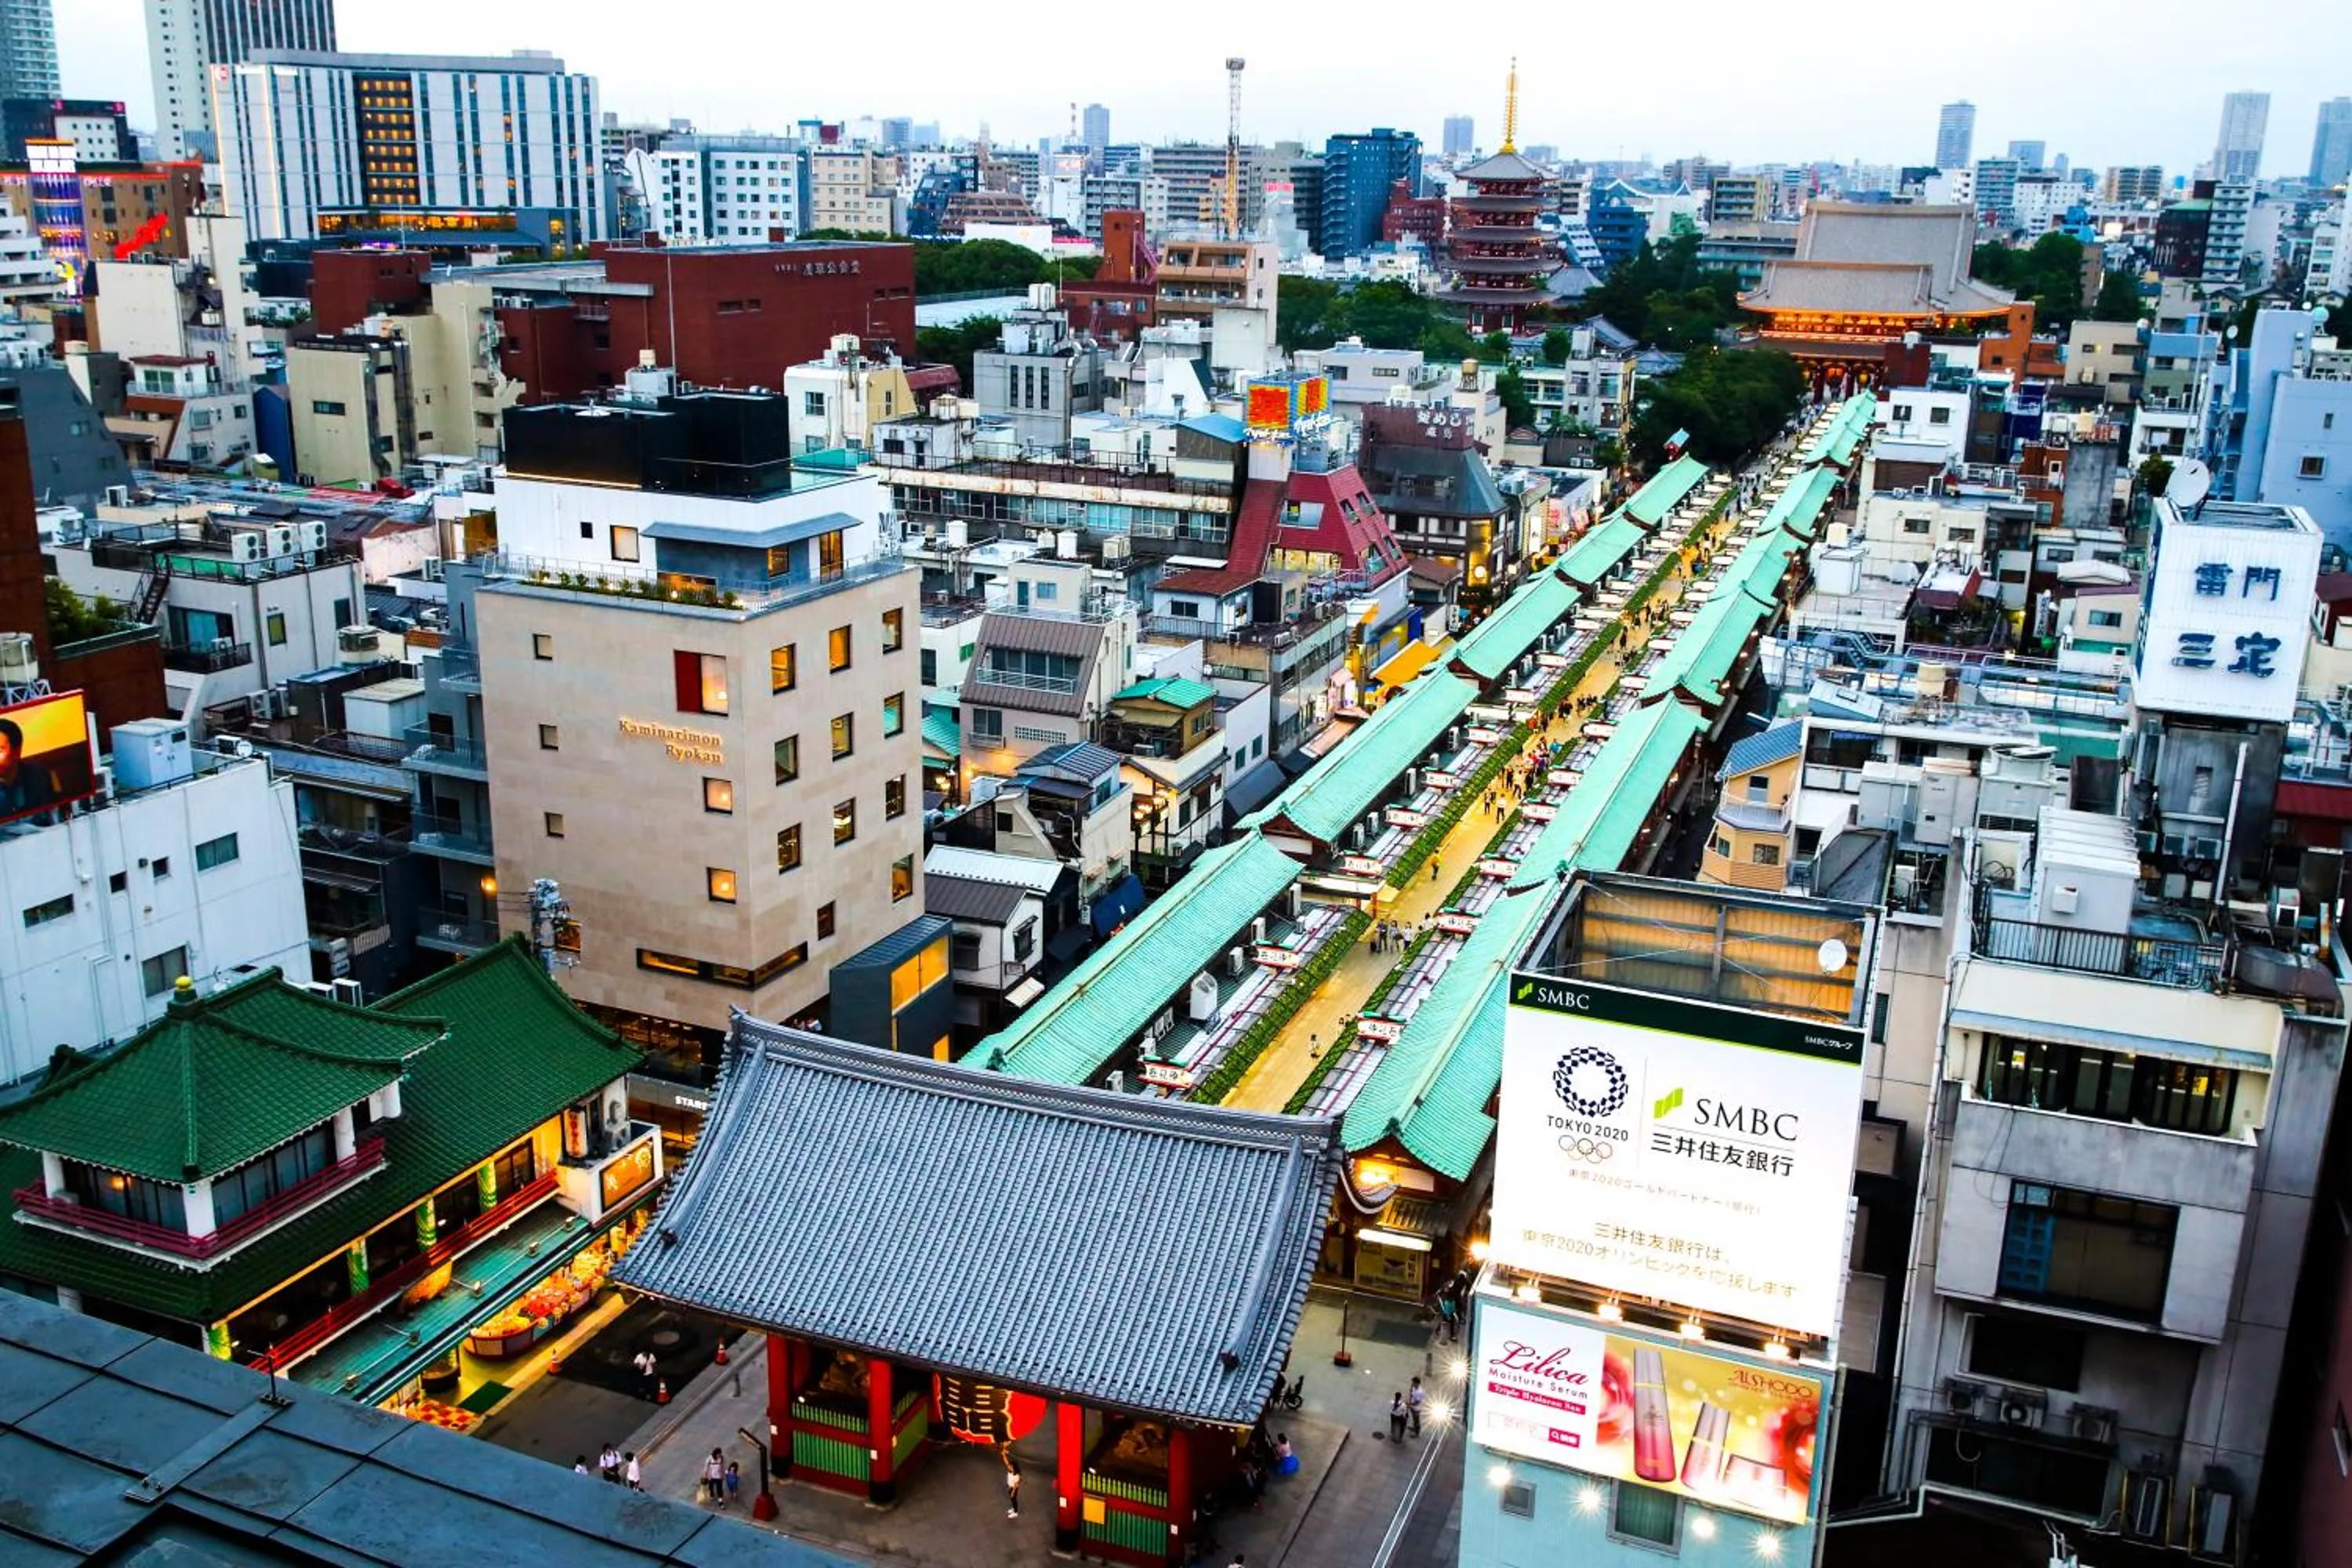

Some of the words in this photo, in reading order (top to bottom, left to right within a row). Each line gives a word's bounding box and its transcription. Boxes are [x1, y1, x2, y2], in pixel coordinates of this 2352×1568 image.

[2195, 563, 2281, 601] 雷門
[2171, 632, 2281, 677] 三定
[619, 718, 720, 746] Kaminarimon
[666, 744, 721, 764] Ryokan
[1537, 987, 1591, 1011] SMBC
[1547, 1115, 1592, 1134] TOKYO
[1594, 1124, 1629, 1142] 2020
[1693, 1098, 1798, 1142] SMBC
[1650, 1132, 1795, 1177] 三井住友銀行
[1490, 1340, 1588, 1385] Lilica
[1490, 1368, 1544, 1388] Moisture
[1550, 1381, 1588, 1400] Serum
